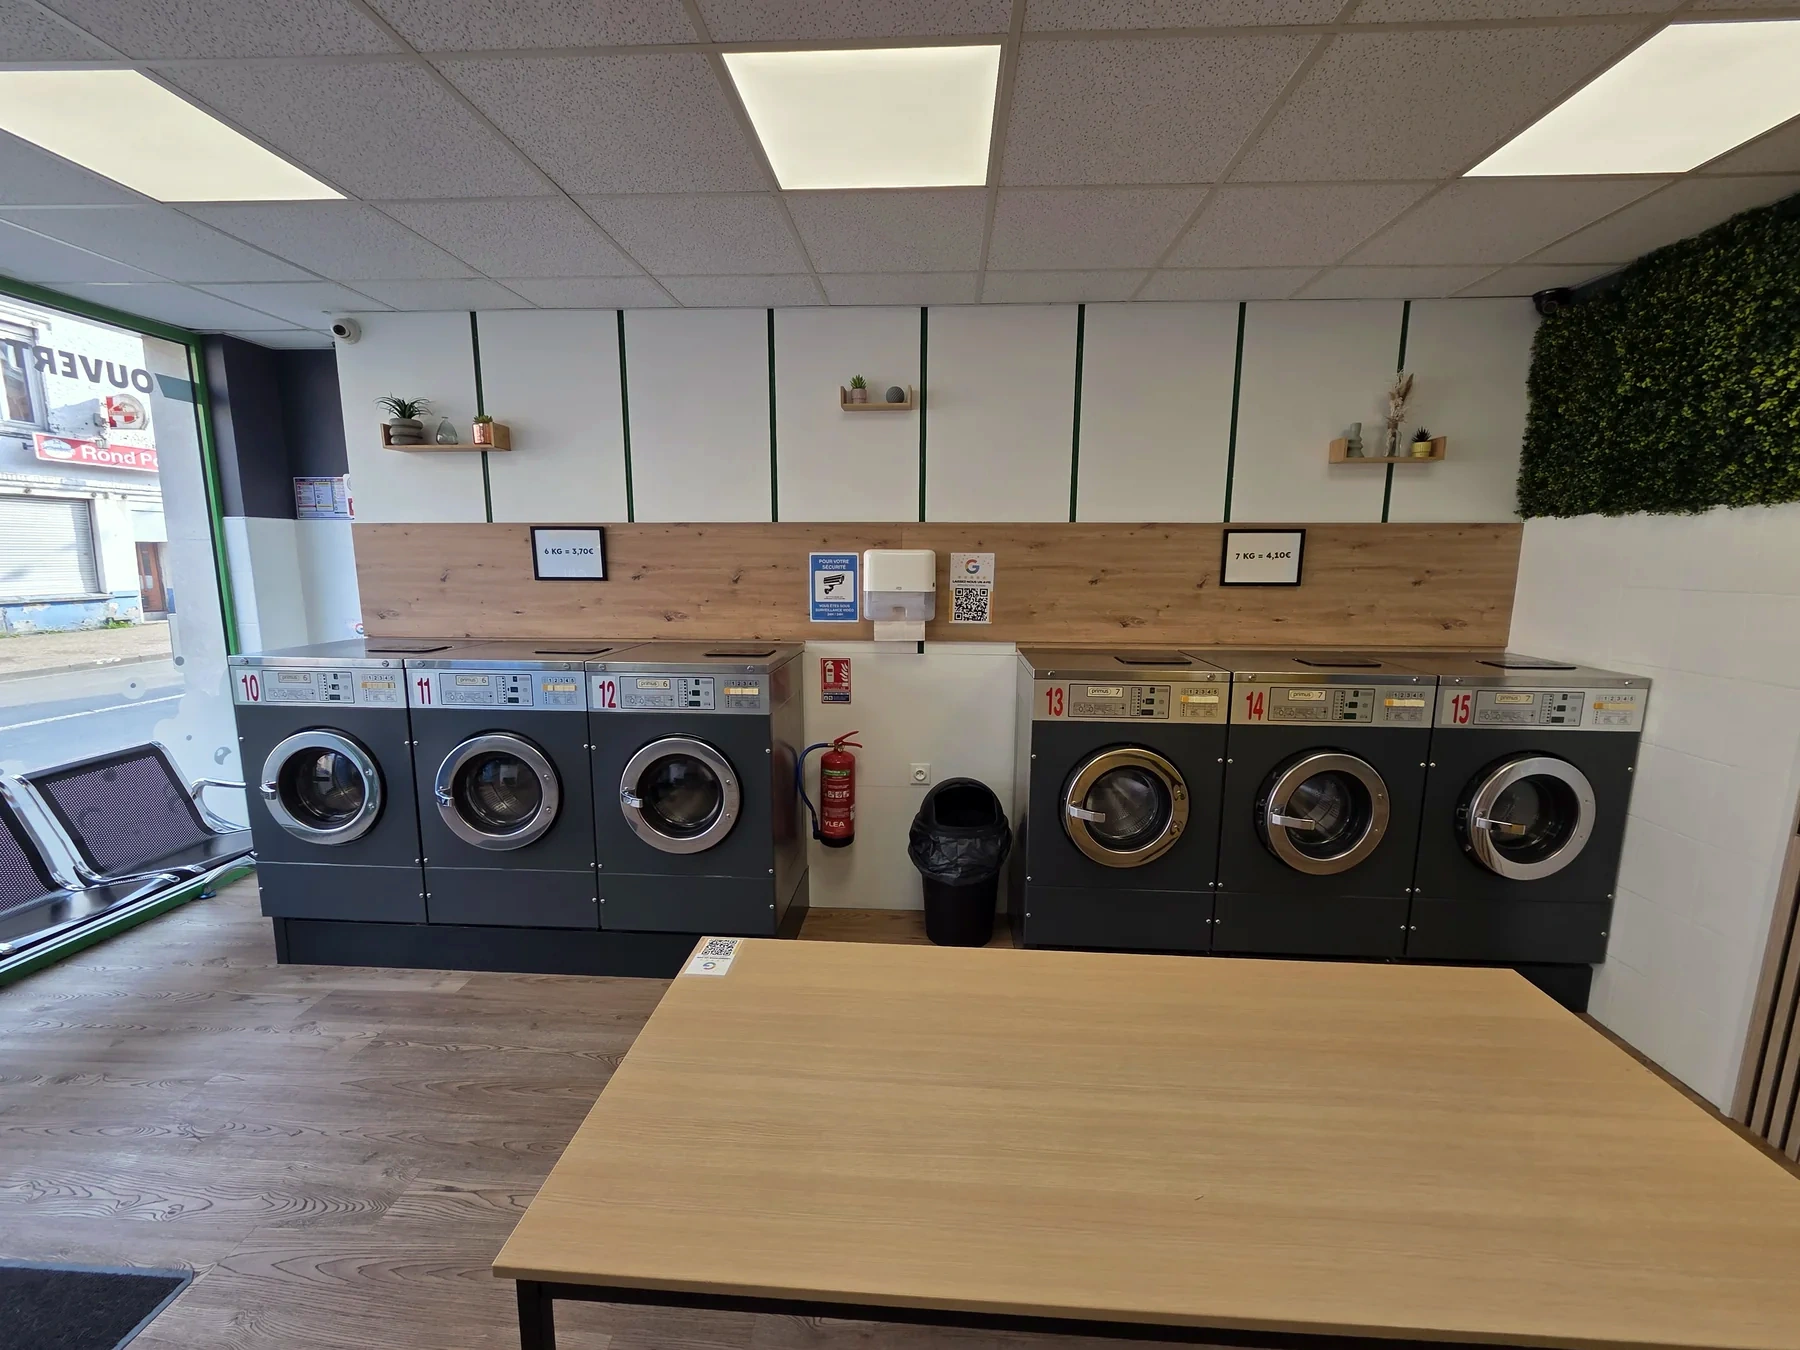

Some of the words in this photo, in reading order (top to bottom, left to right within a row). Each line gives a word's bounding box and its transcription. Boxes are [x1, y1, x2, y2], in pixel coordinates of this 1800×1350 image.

[81, 444, 136, 464] Rond
[1266, 552, 1291, 560] 4,10€
[242, 674, 259, 701] 10
[417, 678, 431, 704] 11
[599, 681, 616, 708] 12
[1046, 687, 1063, 716] 13
[1246, 691, 1263, 720] 14
[1452, 694, 1470, 724] 15
